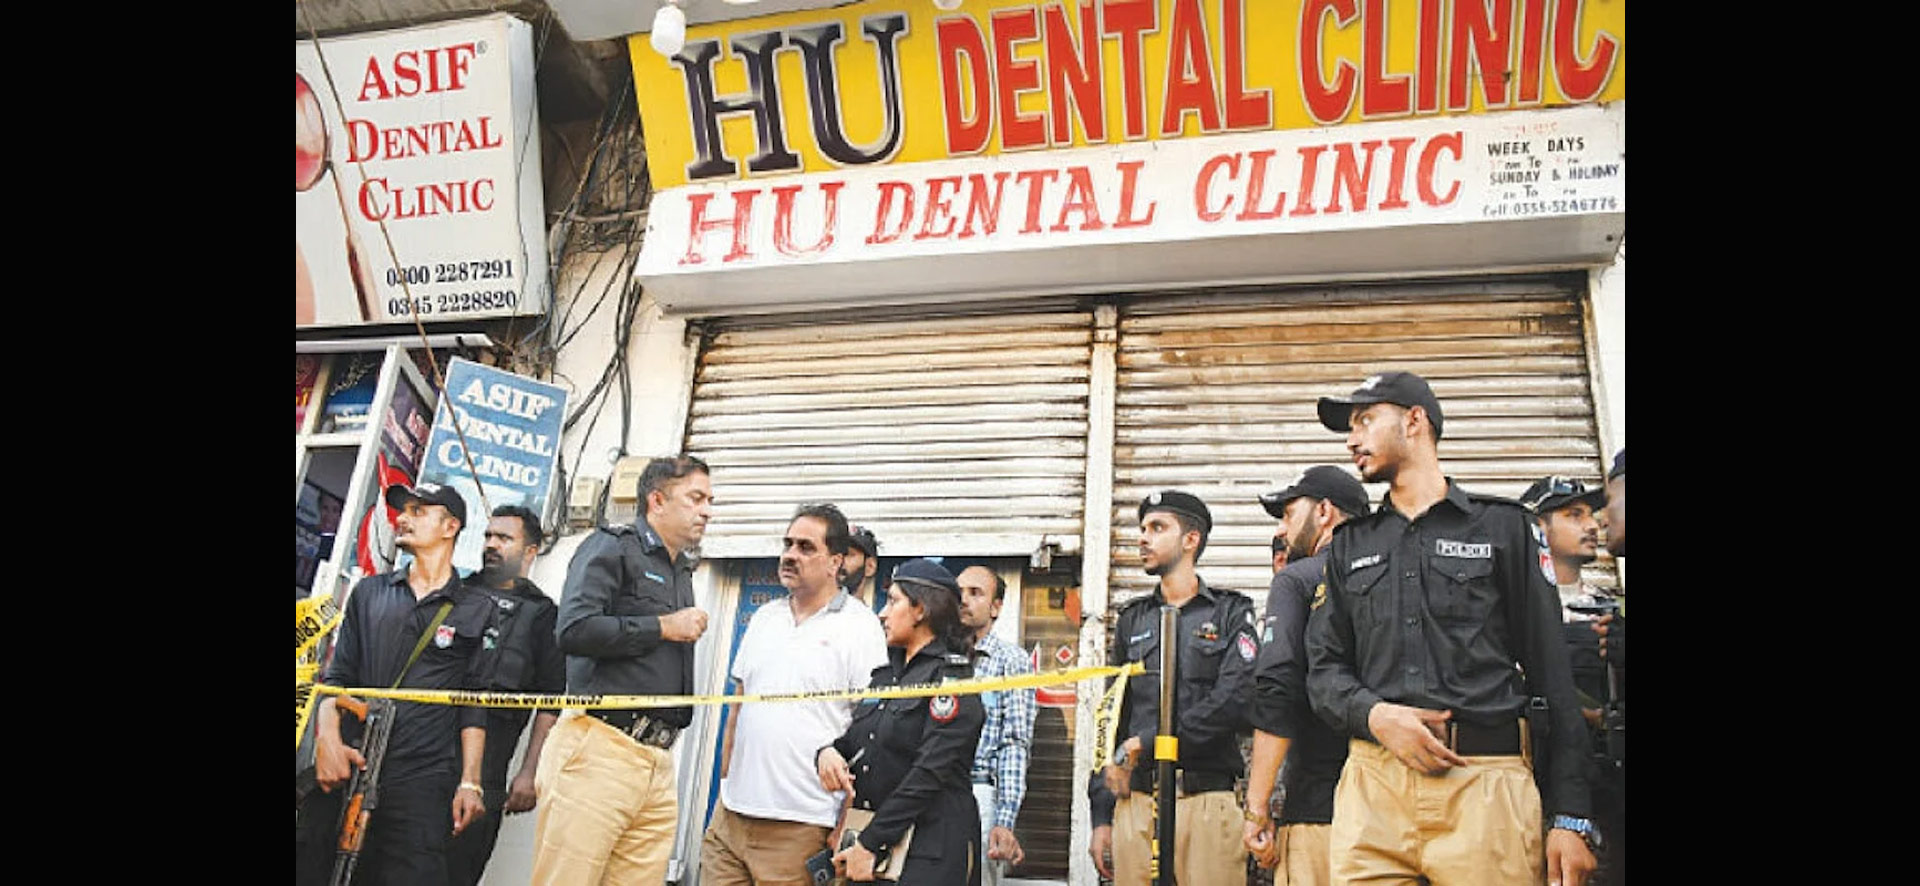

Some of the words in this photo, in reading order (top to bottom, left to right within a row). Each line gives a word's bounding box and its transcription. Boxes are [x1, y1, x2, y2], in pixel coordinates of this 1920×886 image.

[357, 42, 478, 101] ASIF
[671, 15, 909, 179] HU
[935, 0, 1275, 157] DENTAL
[1299, 0, 1621, 126] CLINIC
[345, 116, 503, 163] DENTAL
[1487, 141, 1531, 156] WEEK
[1547, 136, 1585, 152] DAYS
[1489, 170, 1541, 186] SUNDAY
[1569, 163, 1620, 180] HOLIDAY
[358, 178, 495, 222] CLINIC
[677, 182, 846, 265] HU
[865, 160, 1157, 246] DENTAL
[1193, 131, 1464, 228] CLINIC
[435, 259, 513, 283] 2287291
[437, 290, 516, 313] 2228820
[458, 379, 553, 420] ASIF
[438, 404, 553, 457] DENTAL
[438, 439, 540, 487] CLINIC
